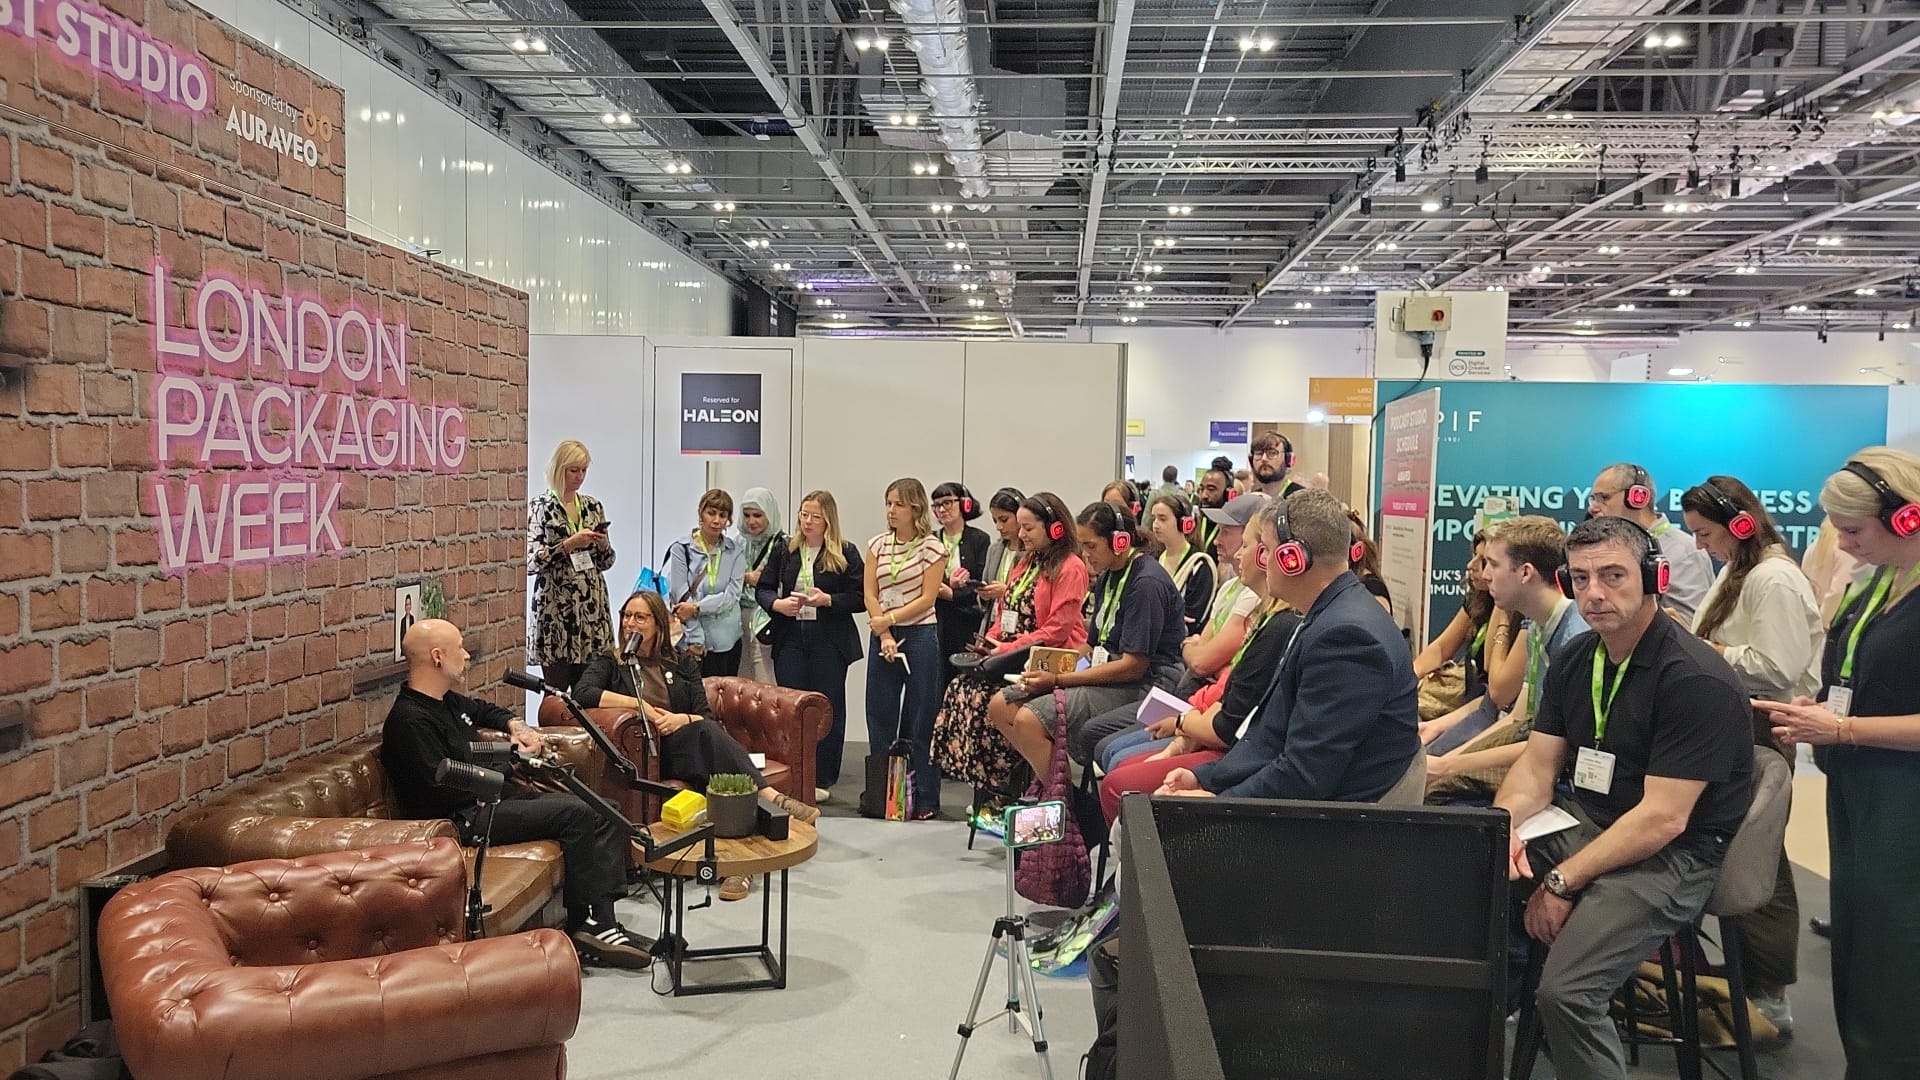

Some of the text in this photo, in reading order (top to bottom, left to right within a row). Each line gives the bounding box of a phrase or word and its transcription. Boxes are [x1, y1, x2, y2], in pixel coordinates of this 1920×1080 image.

[56, 0, 208, 111] STUDIO
[229, 73, 297, 123] Sponsored by
[226, 104, 318, 167] AURAVEO
[155, 266, 406, 386] LONDON
[158, 376, 466, 468] PACKAGING
[683, 409, 759, 423] HALEON
[702, 396, 740, 404] Reserved for
[1390, 407, 1427, 431] PODCAST STUDIO
[1396, 433, 1419, 453] SCHEDULE
[156, 482, 343, 568] WEEK
[1432, 569, 1462, 581] UK'S
